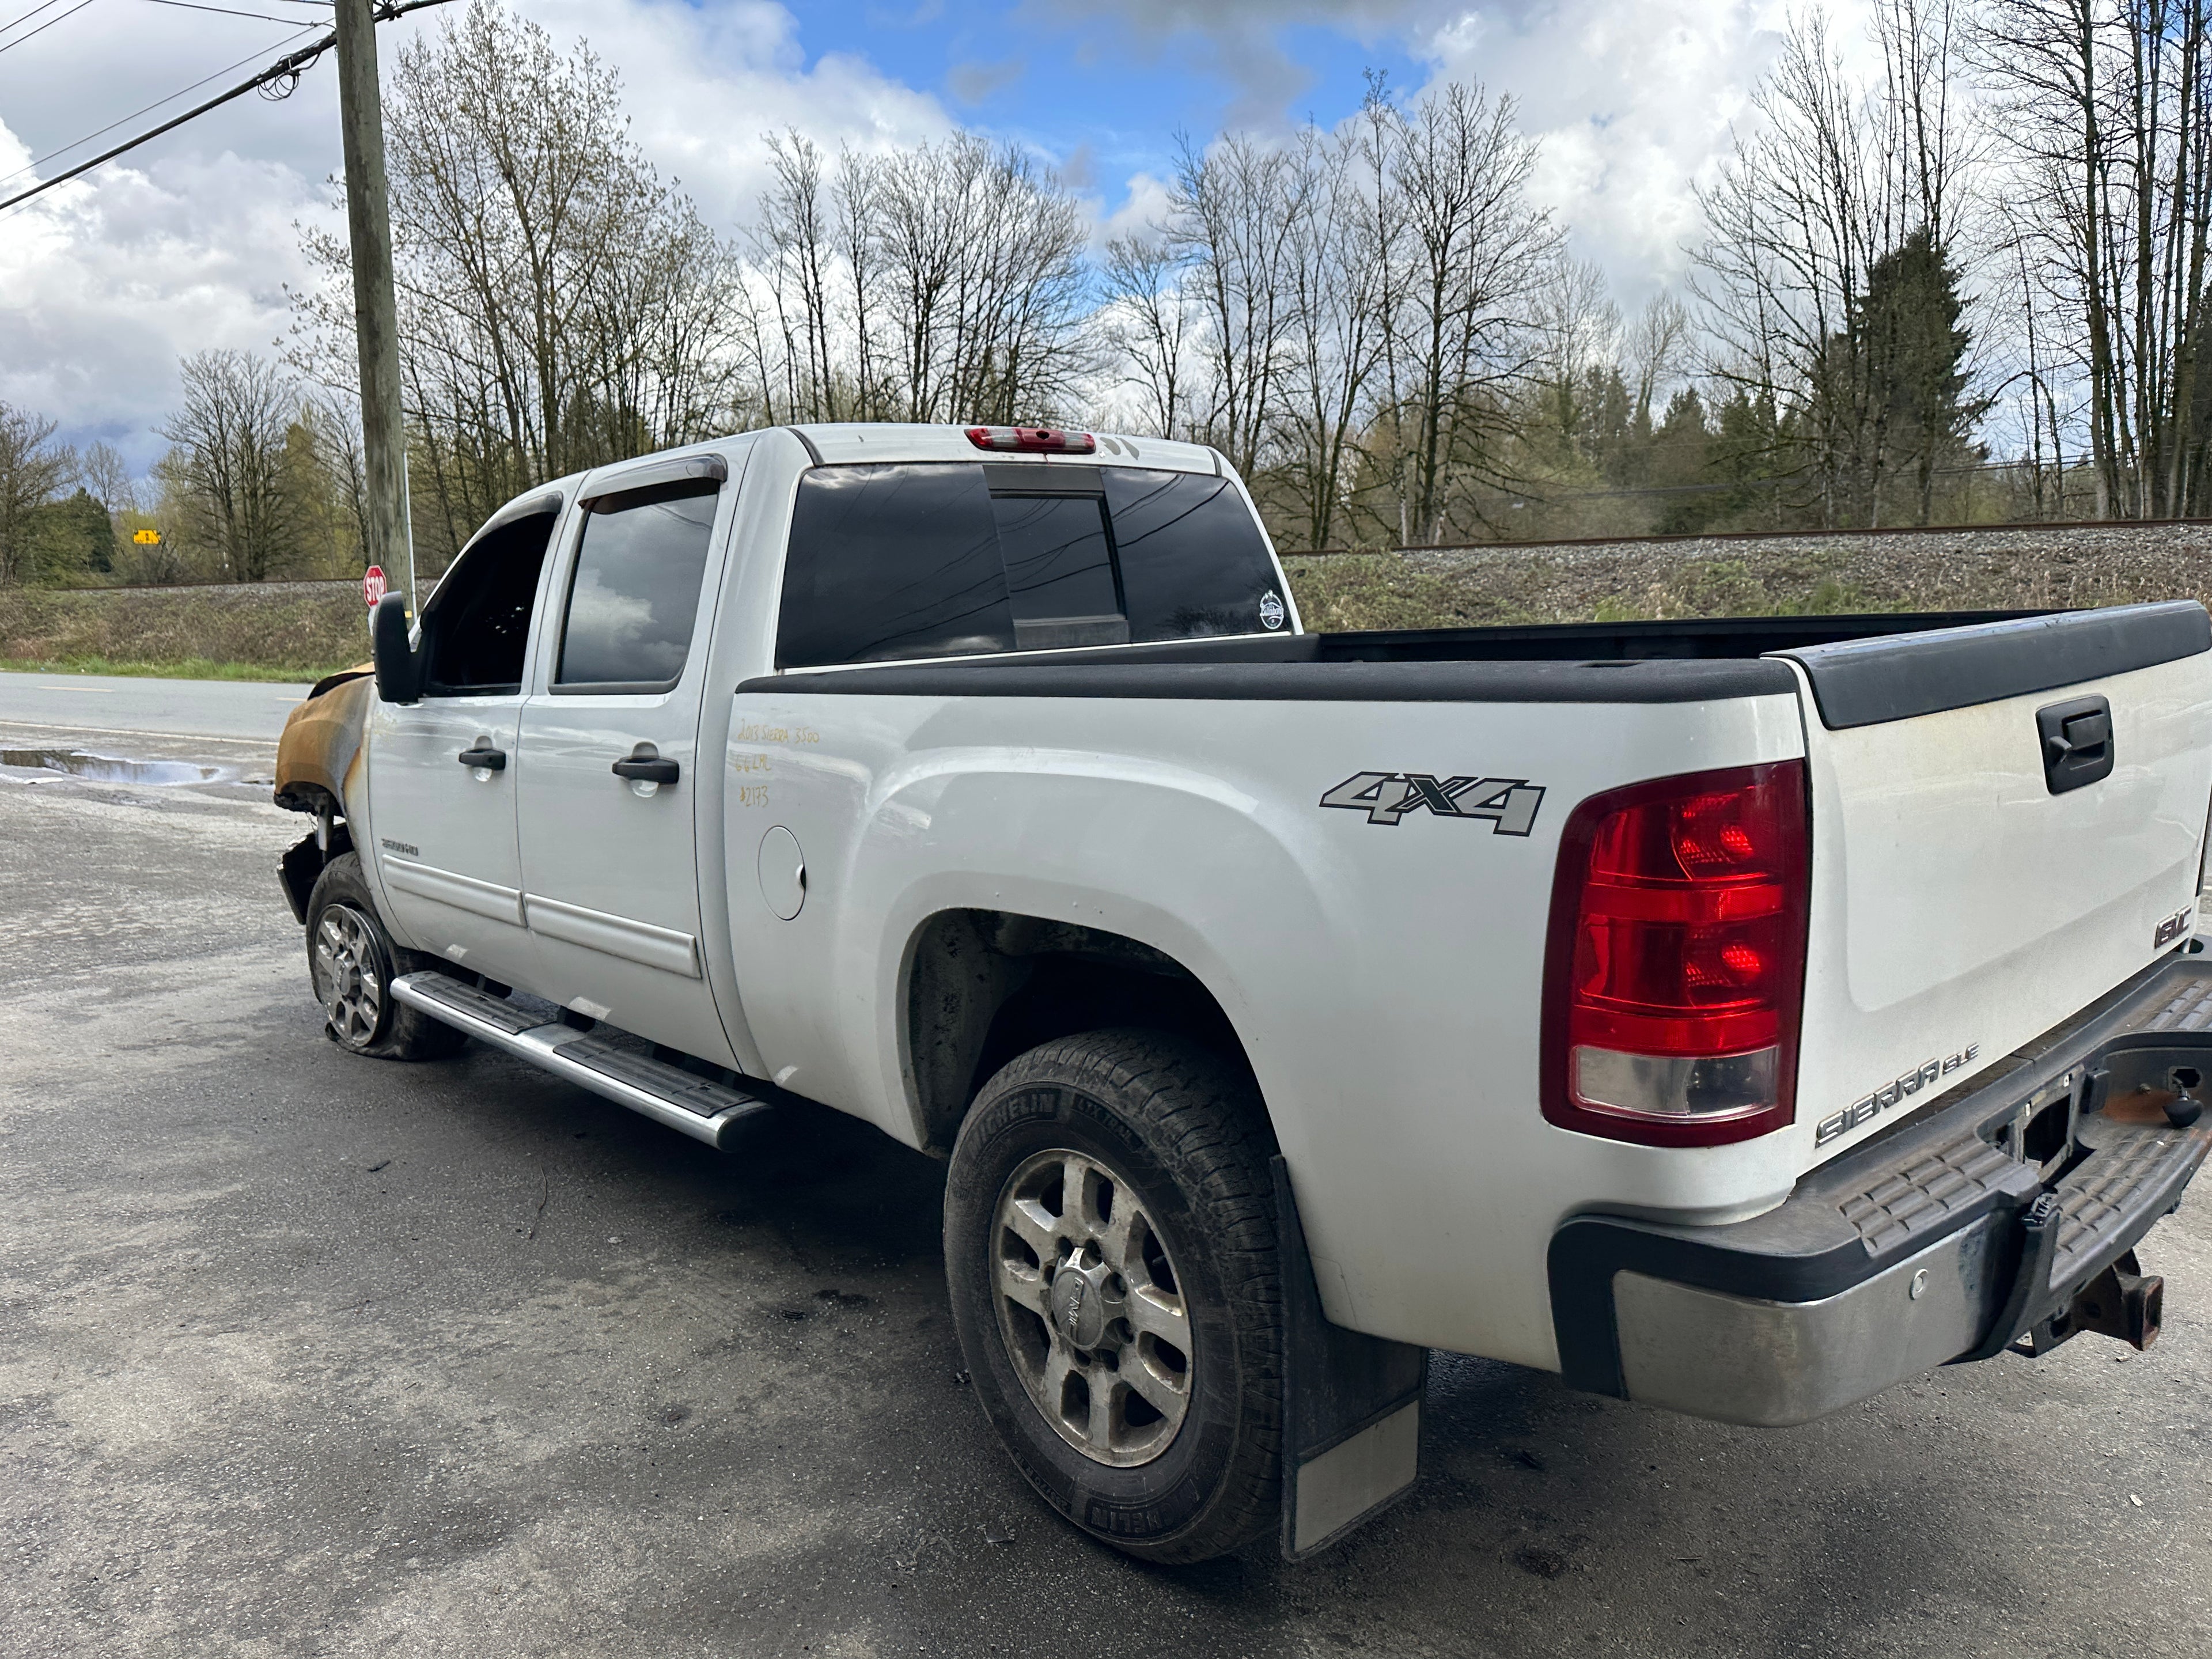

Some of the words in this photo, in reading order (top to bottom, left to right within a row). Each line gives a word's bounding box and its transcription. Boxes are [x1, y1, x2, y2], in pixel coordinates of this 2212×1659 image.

[366, 576, 385, 601] STOP
[738, 718, 759, 741] 2013
[794, 727, 820, 743] 3500
[1815, 1058, 1940, 1149] SIERRA
[1942, 1043, 1979, 1075] SLE
[967, 1092, 1055, 1161] MICHELIN
